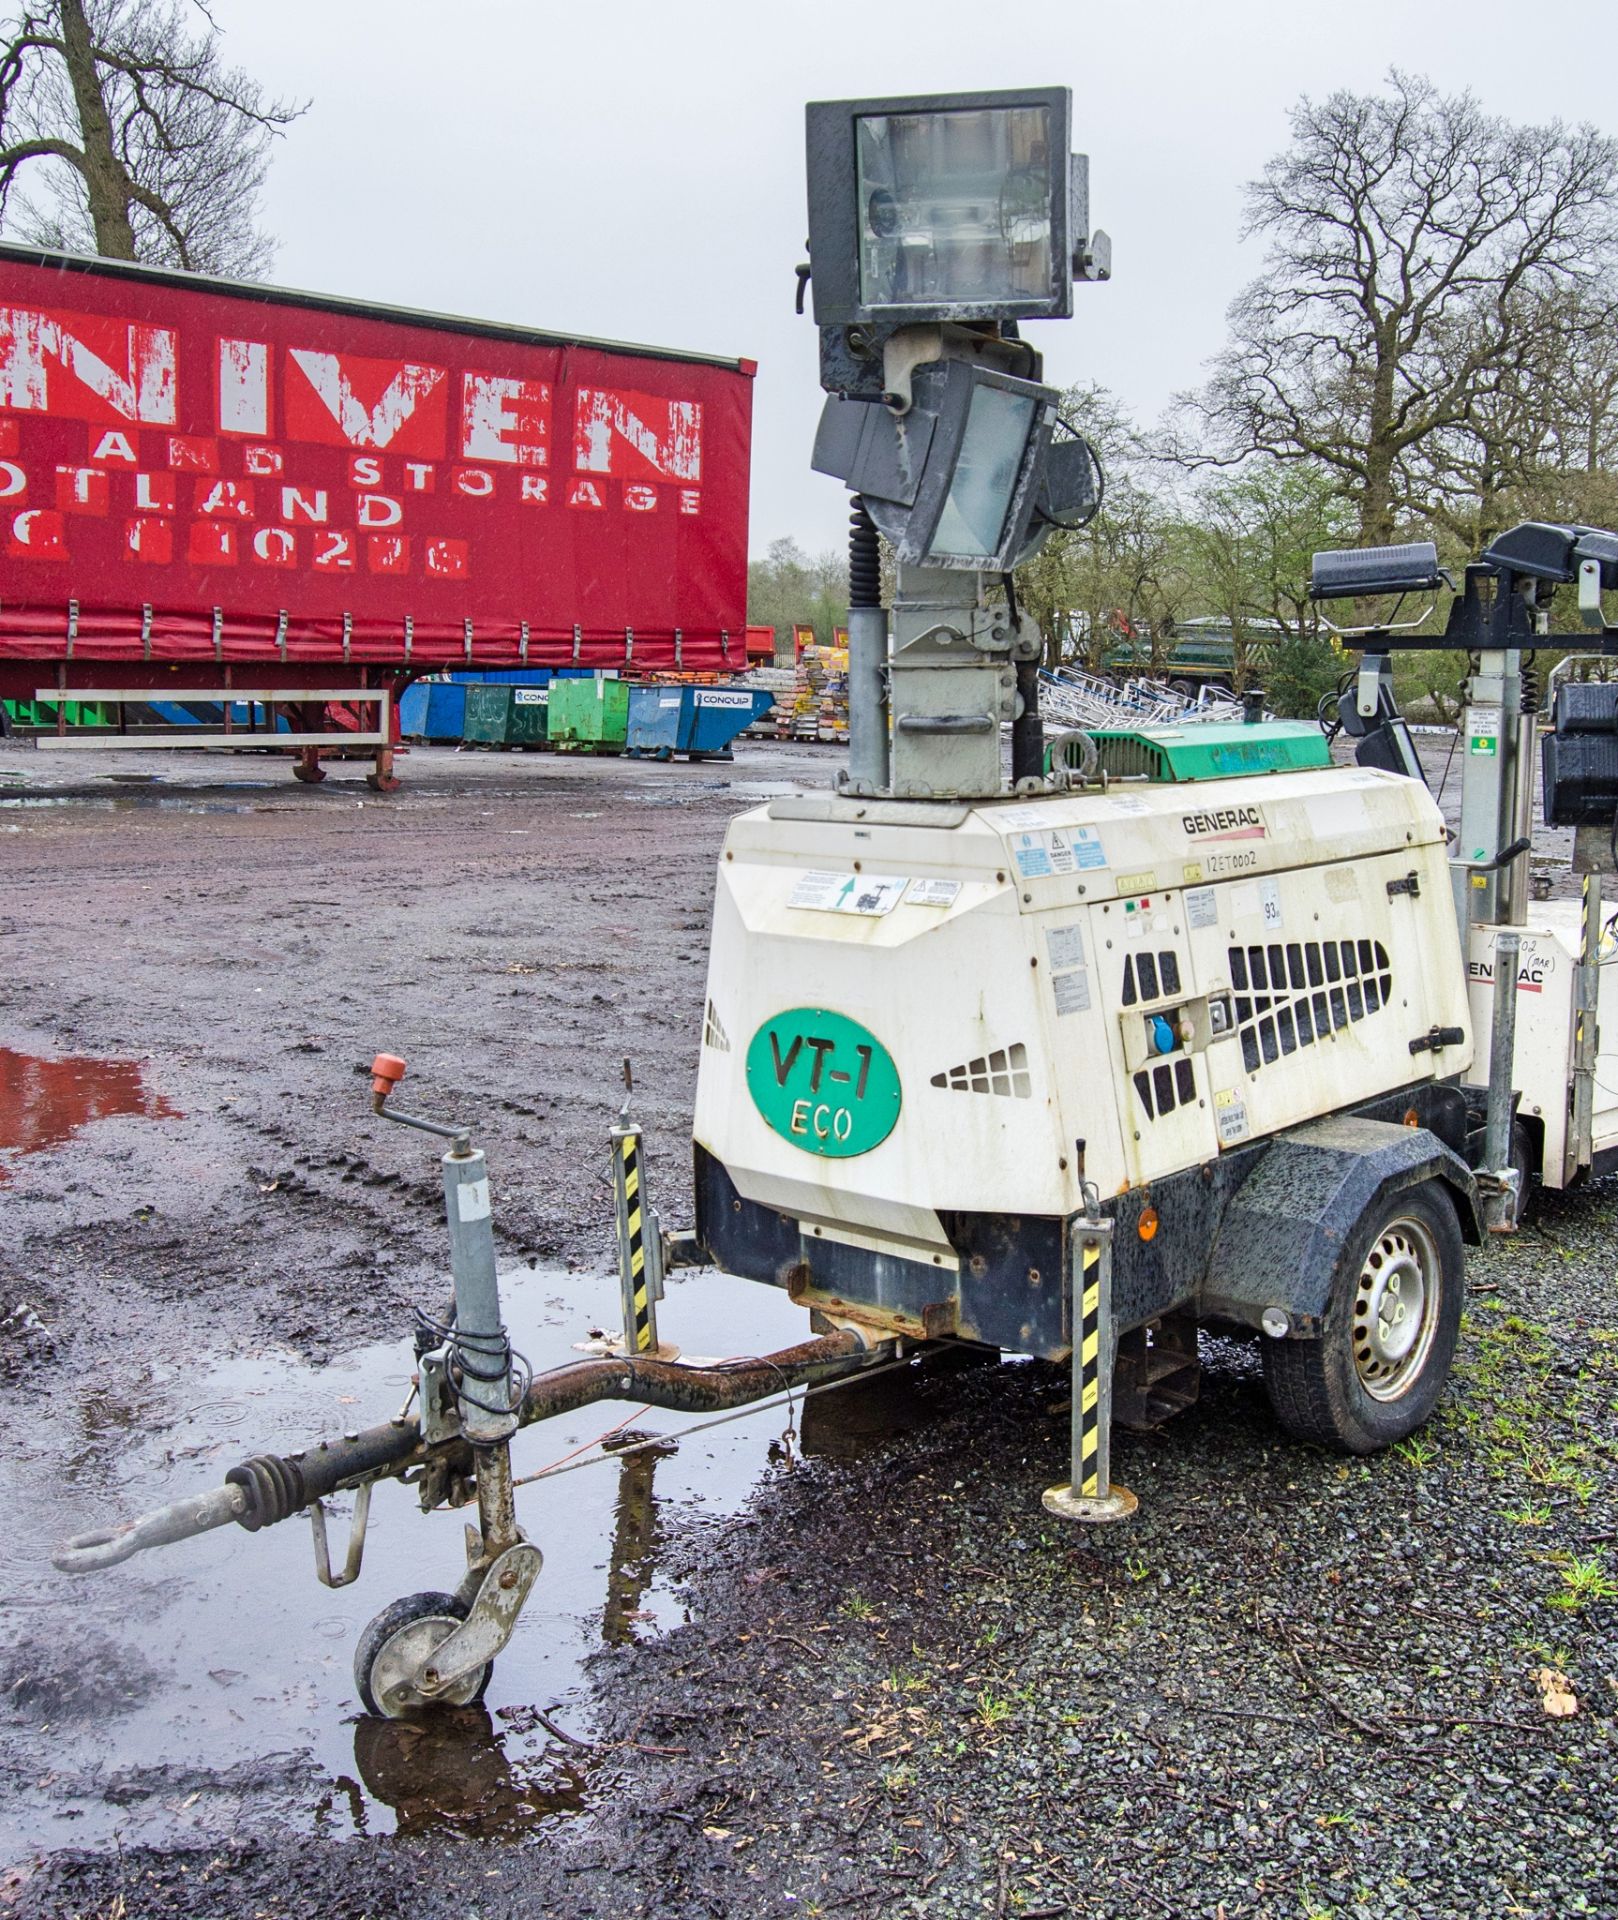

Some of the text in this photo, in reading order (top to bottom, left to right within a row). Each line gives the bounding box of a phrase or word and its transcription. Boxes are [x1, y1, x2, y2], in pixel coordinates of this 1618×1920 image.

[0, 307, 701, 480] NIVEN
[352, 457, 700, 515] STORAGE
[703, 695, 749, 704] CONQUIP
[1183, 807, 1260, 835] GENERAC
[1049, 850, 1072, 858] DANGER
[1206, 850, 1257, 873] 12ET0002
[1264, 902, 1276, 920] 93
[769, 1030, 873, 1101] VT-1
[790, 1099, 853, 1141] ECO
